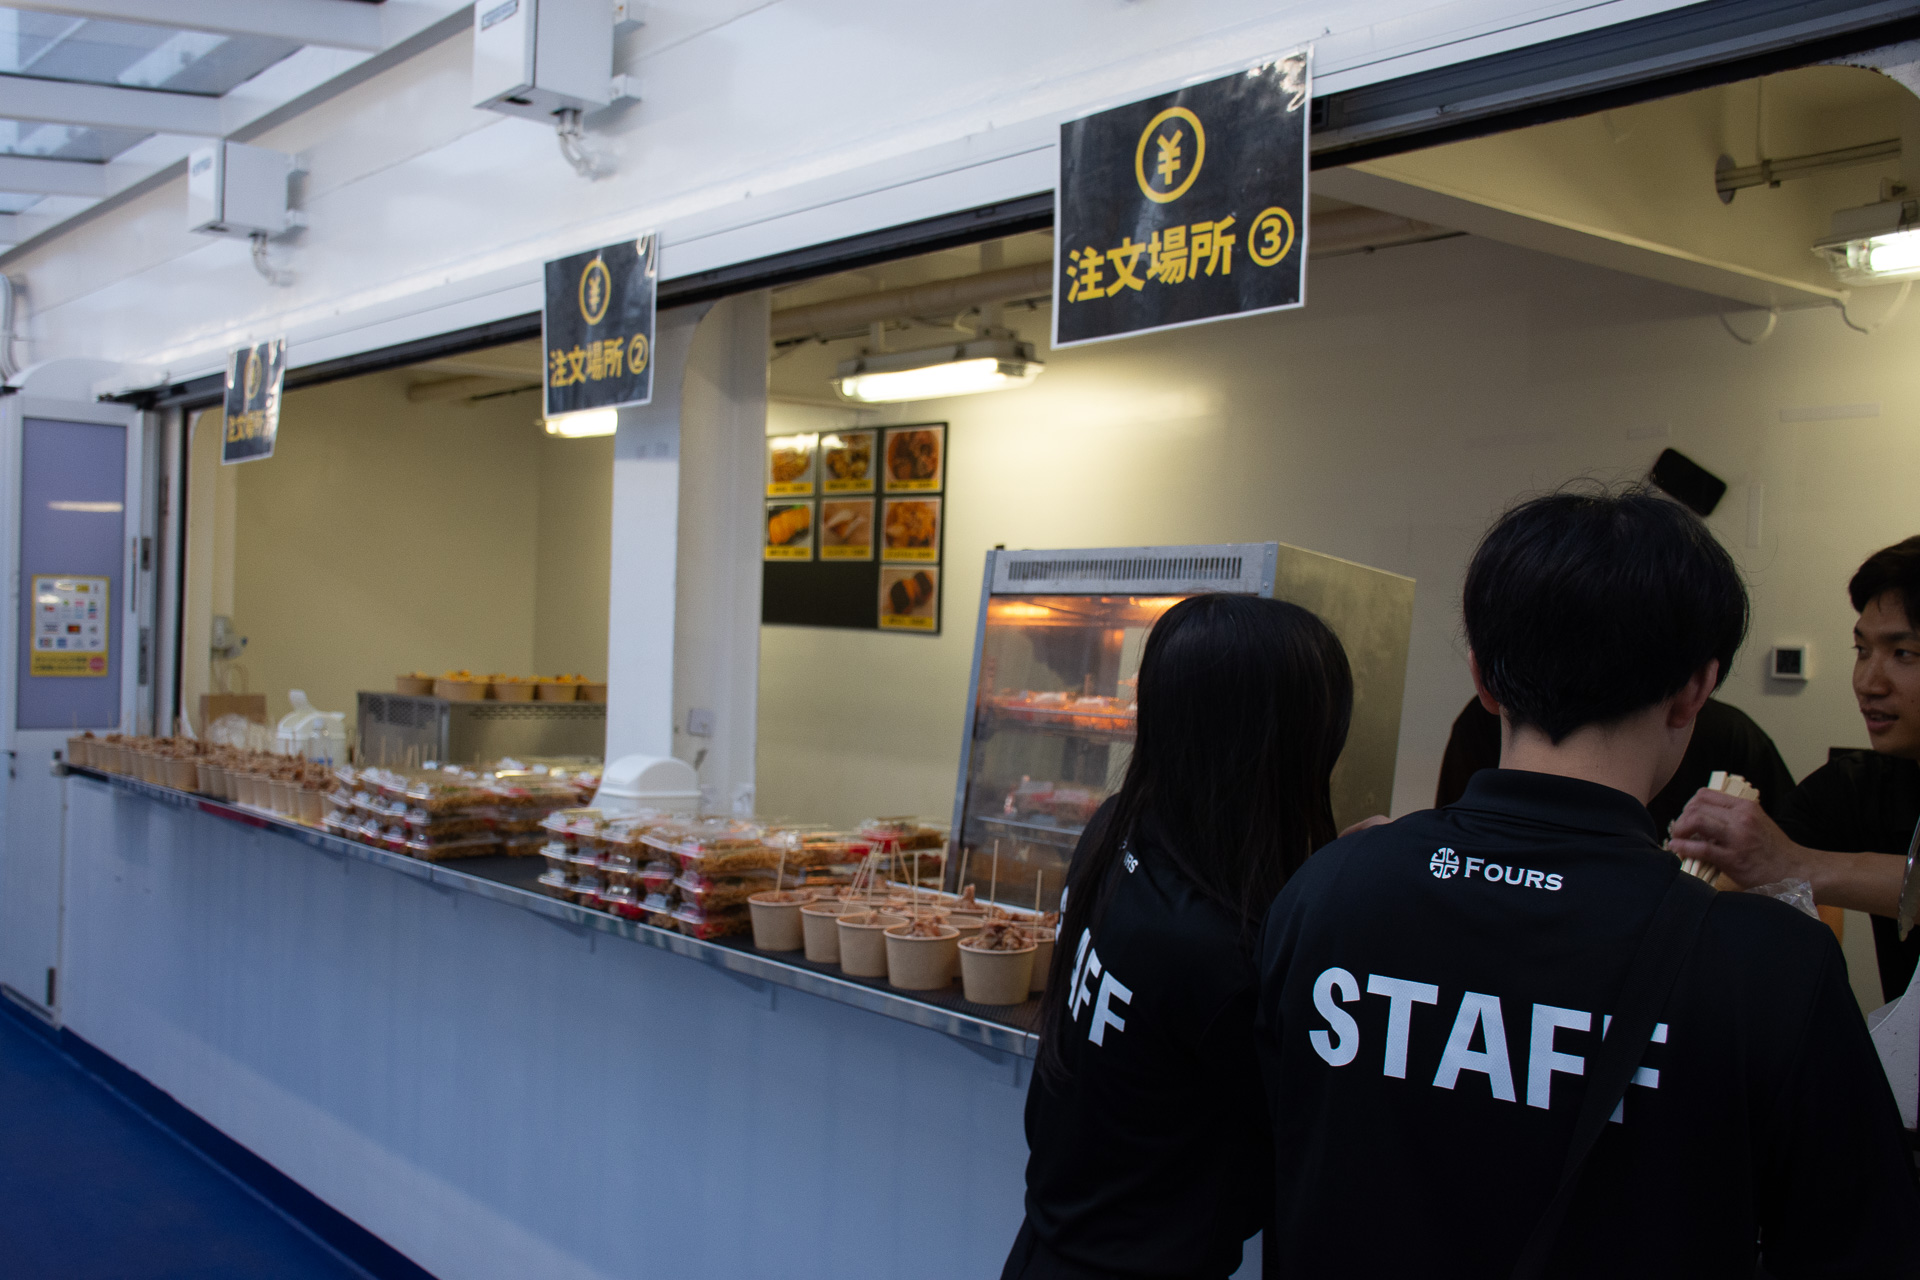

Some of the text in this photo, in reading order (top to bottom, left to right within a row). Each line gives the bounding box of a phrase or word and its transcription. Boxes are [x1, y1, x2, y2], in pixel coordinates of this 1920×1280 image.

[1066, 215, 1236, 303] 注文場所
[549, 336, 624, 387] 注文場所
